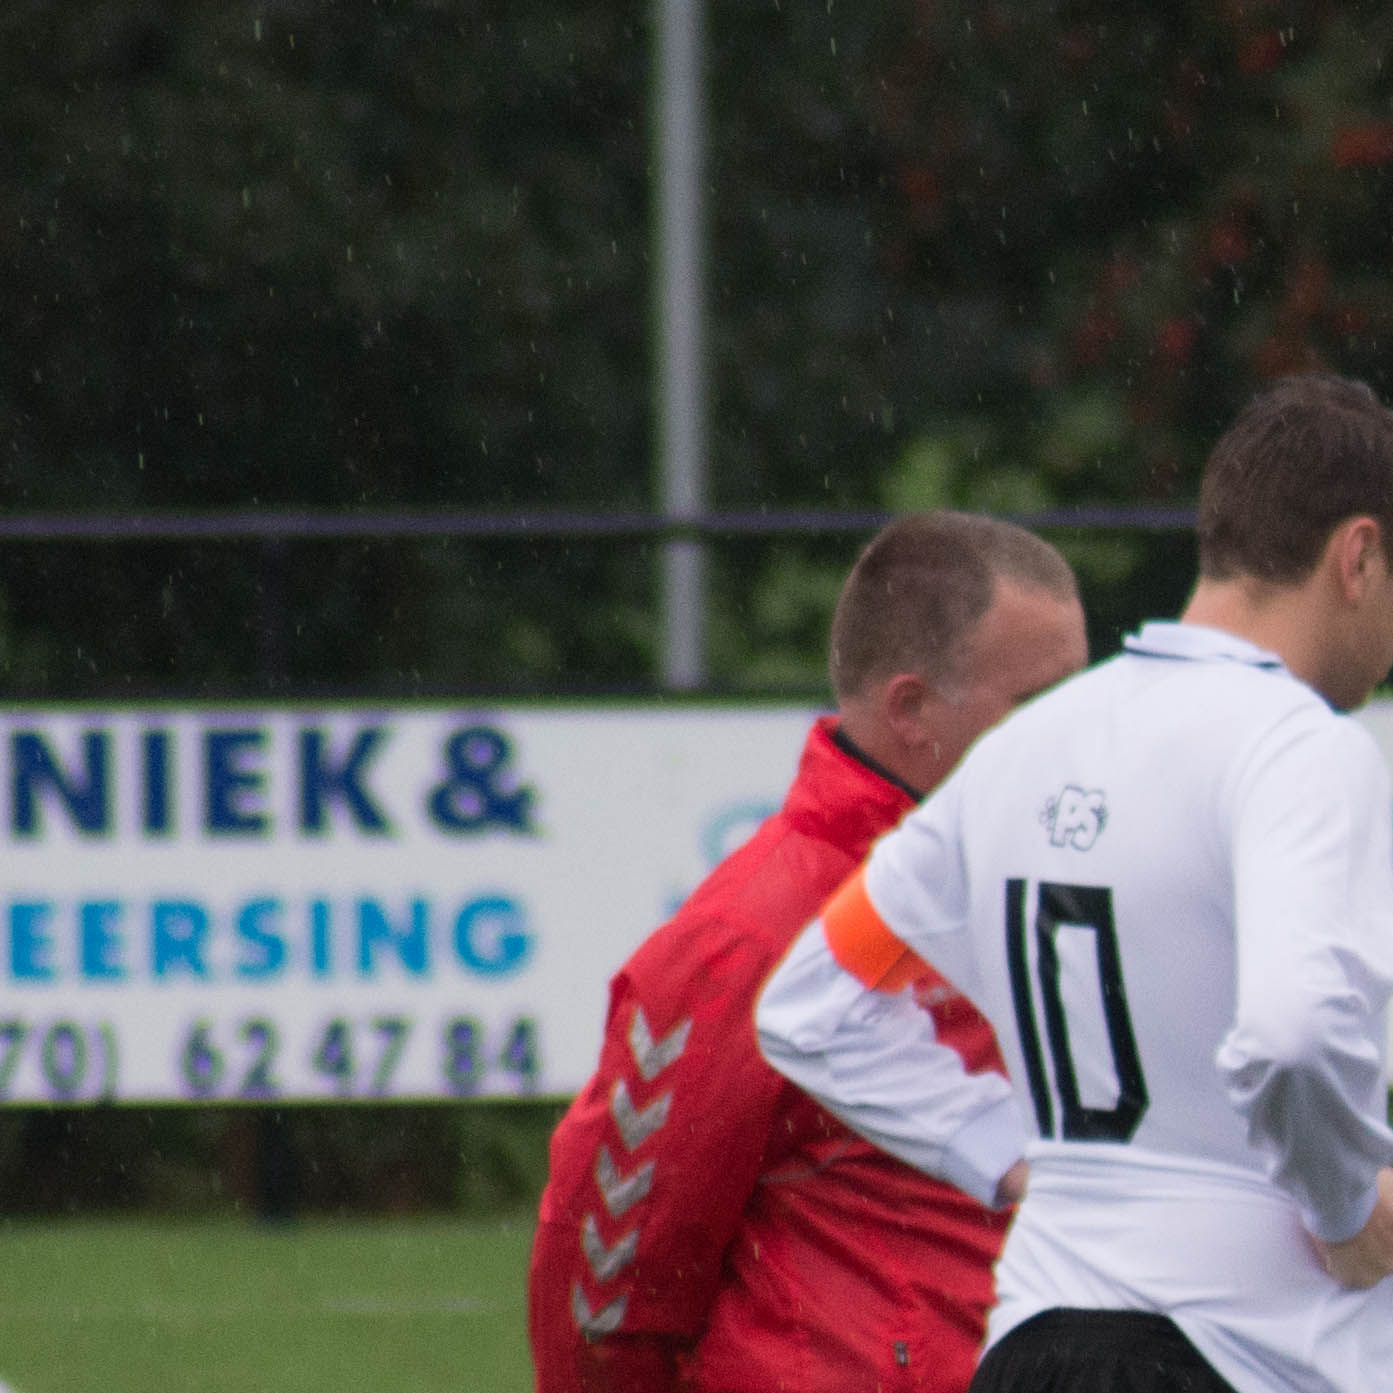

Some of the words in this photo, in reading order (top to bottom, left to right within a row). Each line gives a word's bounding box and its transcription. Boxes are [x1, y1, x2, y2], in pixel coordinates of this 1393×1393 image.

[9, 725, 400, 841] NIEK
[426, 724, 546, 842] &
[8, 894, 534, 981] EERSING
[1004, 877, 1151, 1145] 10
